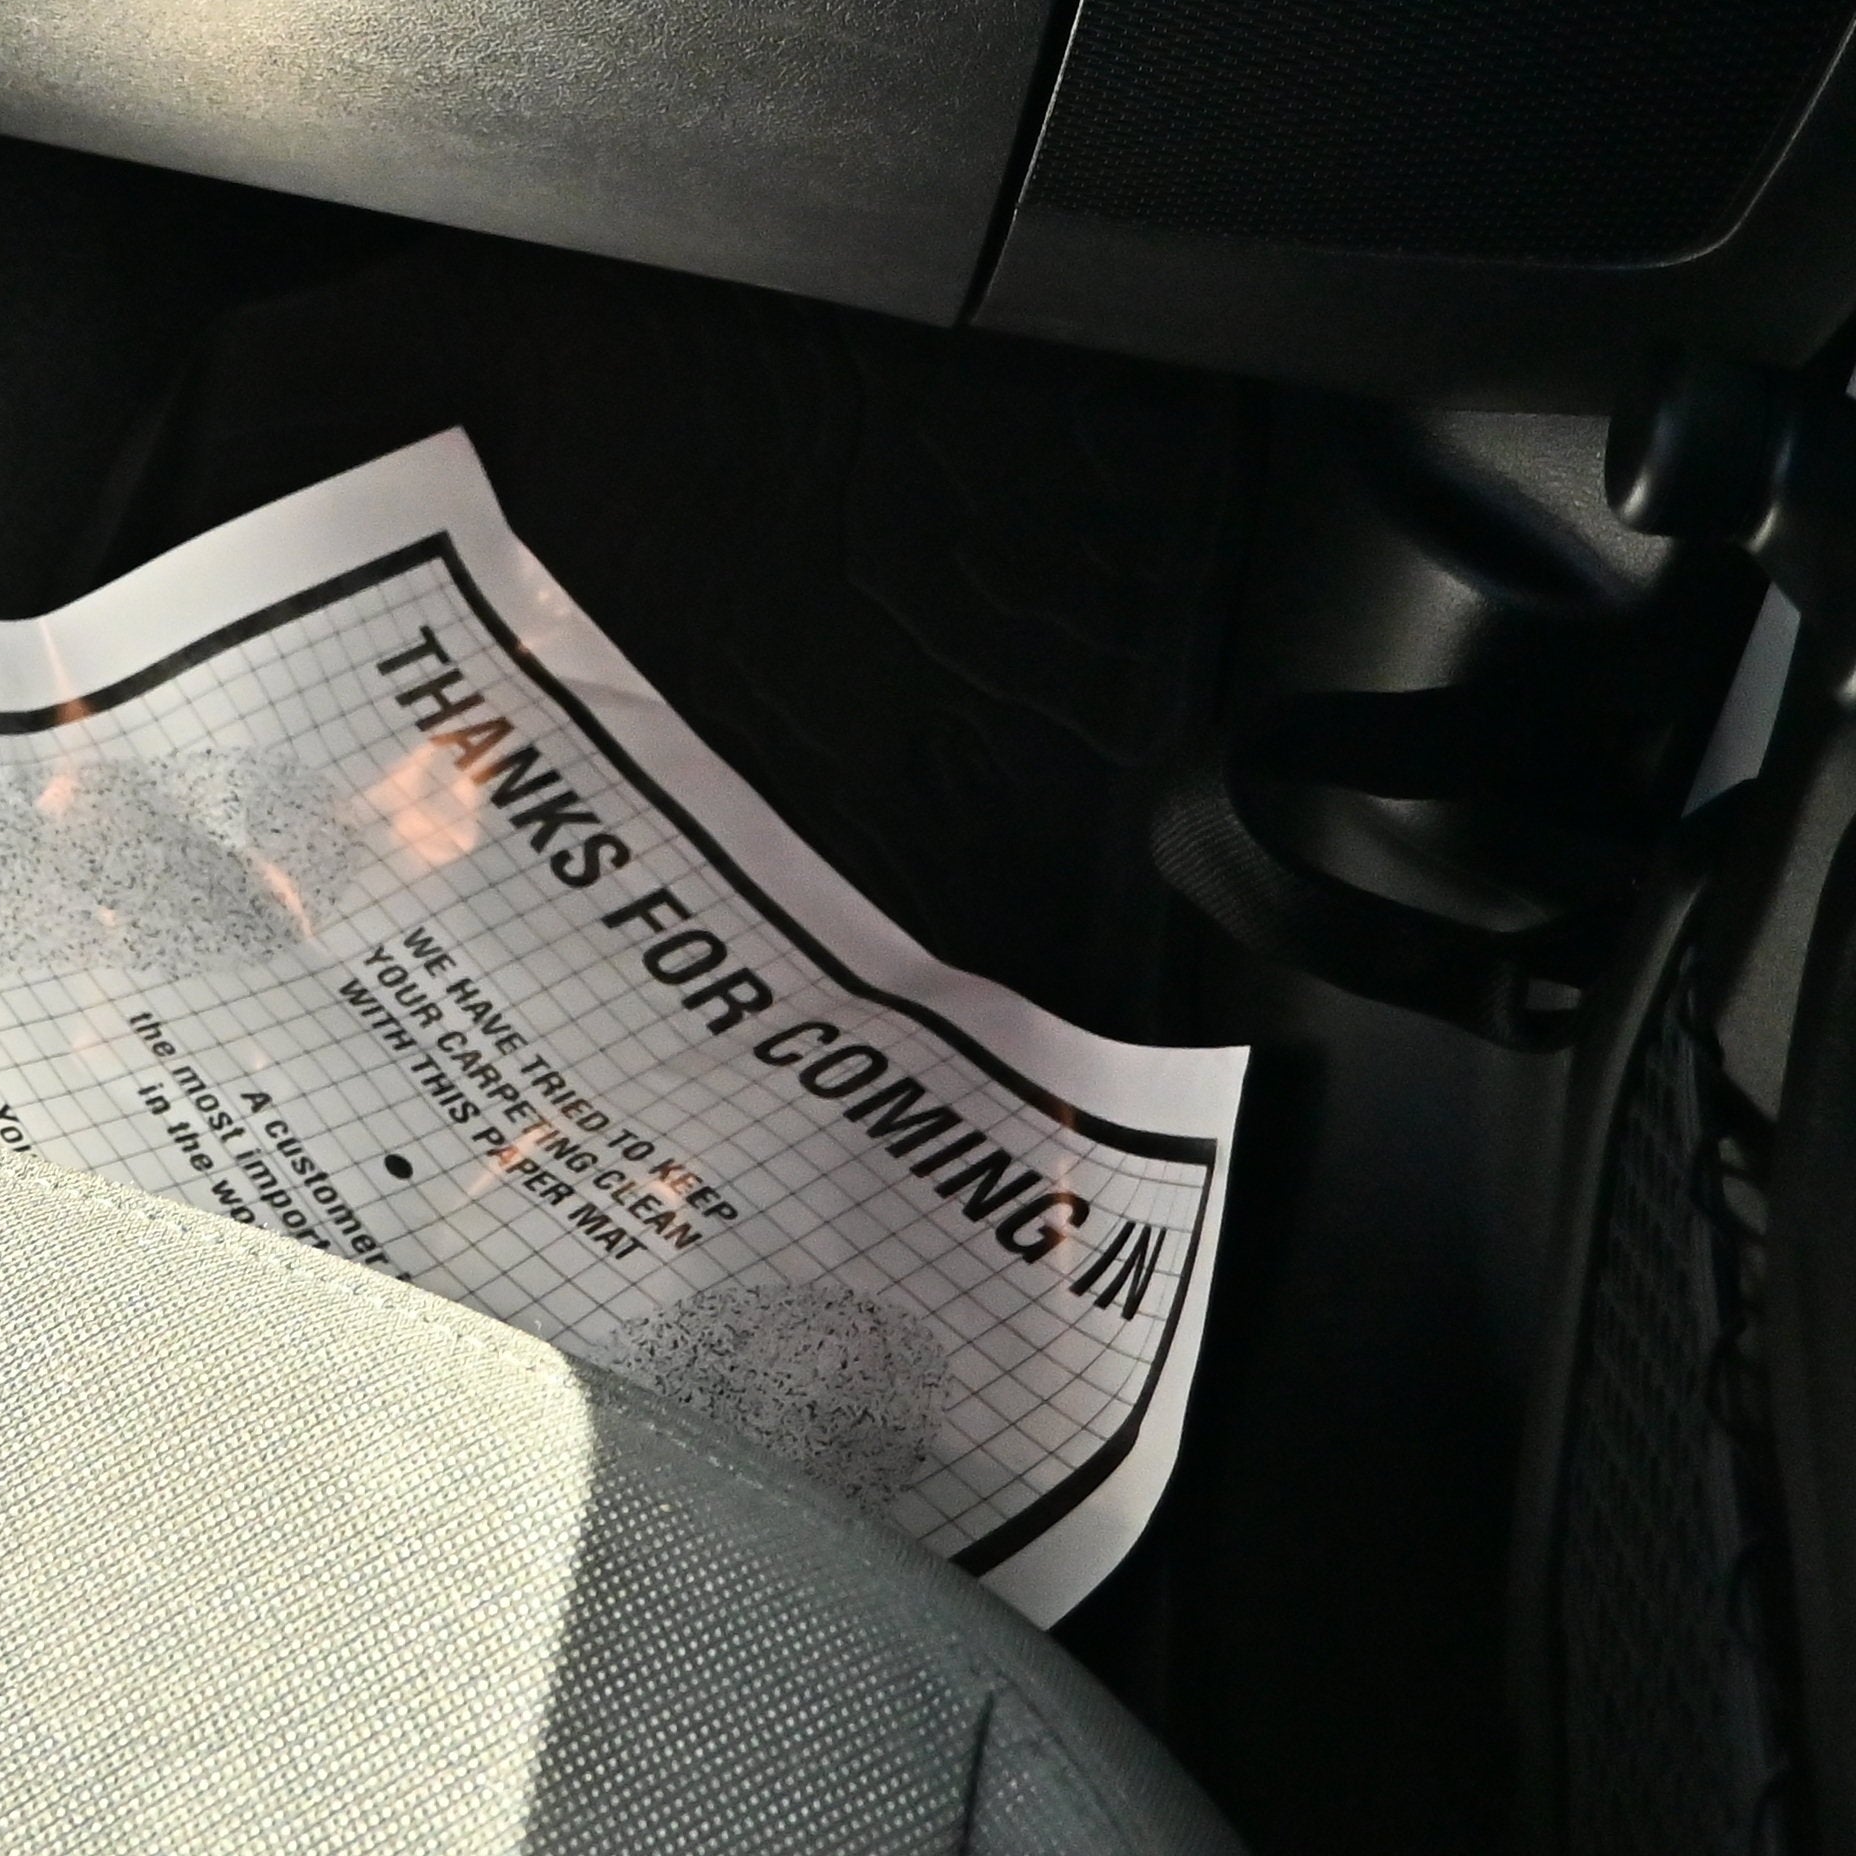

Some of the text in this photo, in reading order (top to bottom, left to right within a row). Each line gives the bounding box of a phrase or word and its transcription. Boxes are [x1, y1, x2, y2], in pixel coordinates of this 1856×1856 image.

[129, 1011, 177, 1058] the
[172, 1065, 246, 1144] most
[364, 943, 704, 1251] YOUR CARPETING CLEAN
[375, 625, 1168, 1321] THANKS FOR COMING IN
[403, 926, 739, 1222] WE HAVE TRIED TO KEEP
[137, 1081, 263, 1230] in the wo
[240, 1092, 390, 1266] A customer
[338, 978, 649, 1262] WITH THIS PAPER MAT
